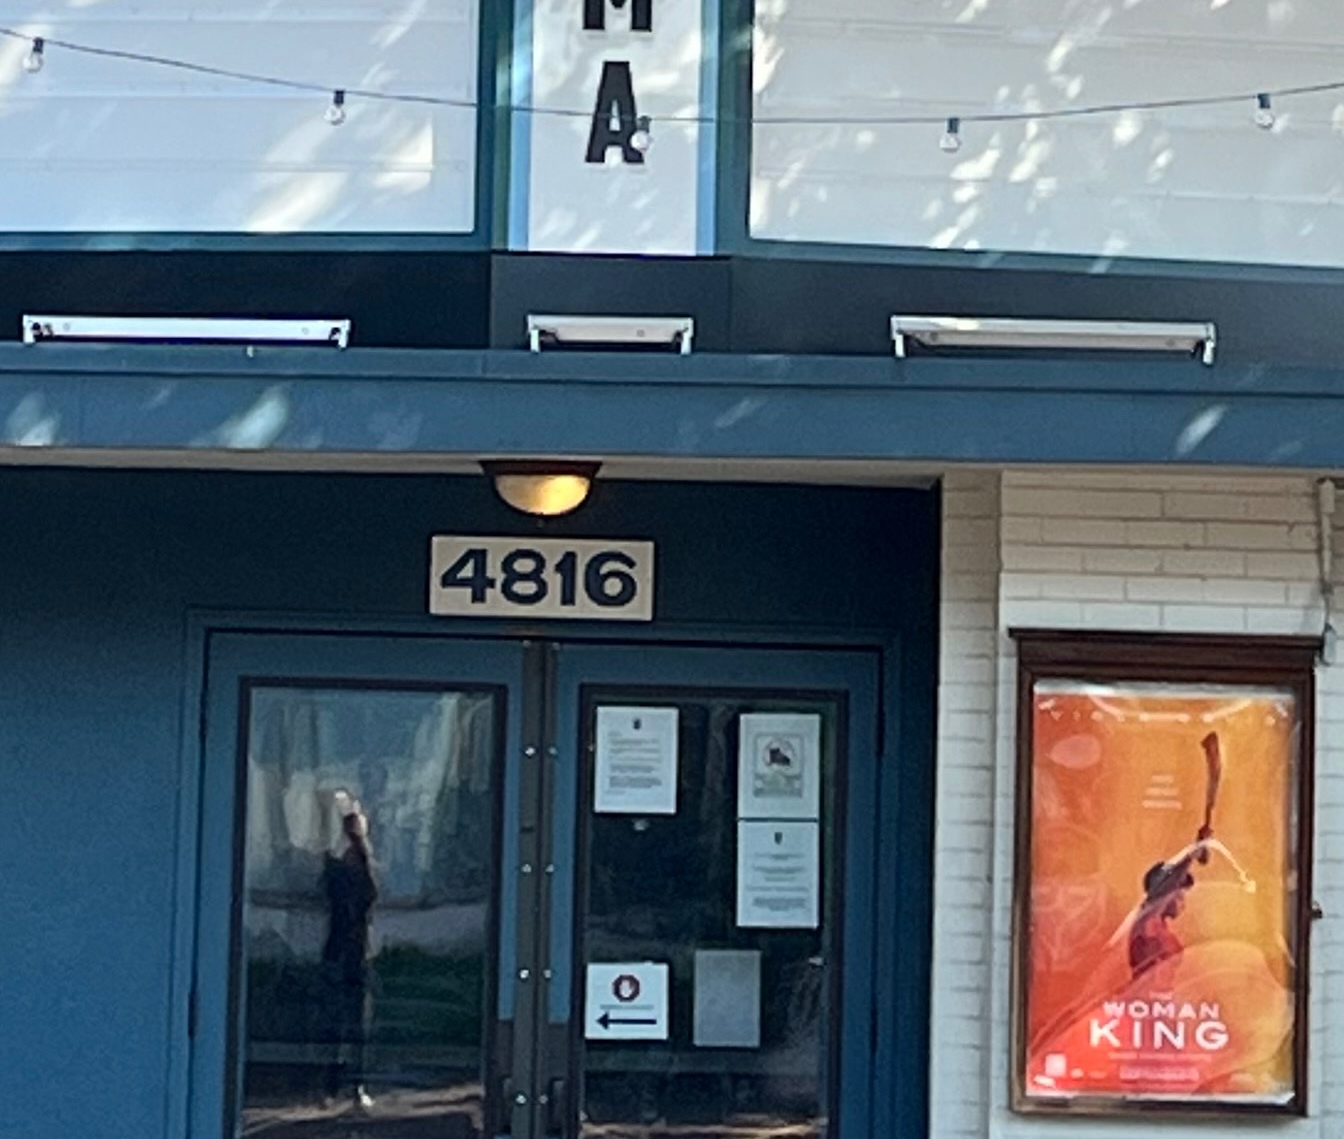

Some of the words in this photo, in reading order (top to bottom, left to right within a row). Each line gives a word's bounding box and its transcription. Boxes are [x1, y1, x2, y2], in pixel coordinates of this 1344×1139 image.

[440, 548, 637, 607] 4816
[1103, 1001, 1220, 1020] WOMAN
[1089, 1018, 1229, 1050] KING
